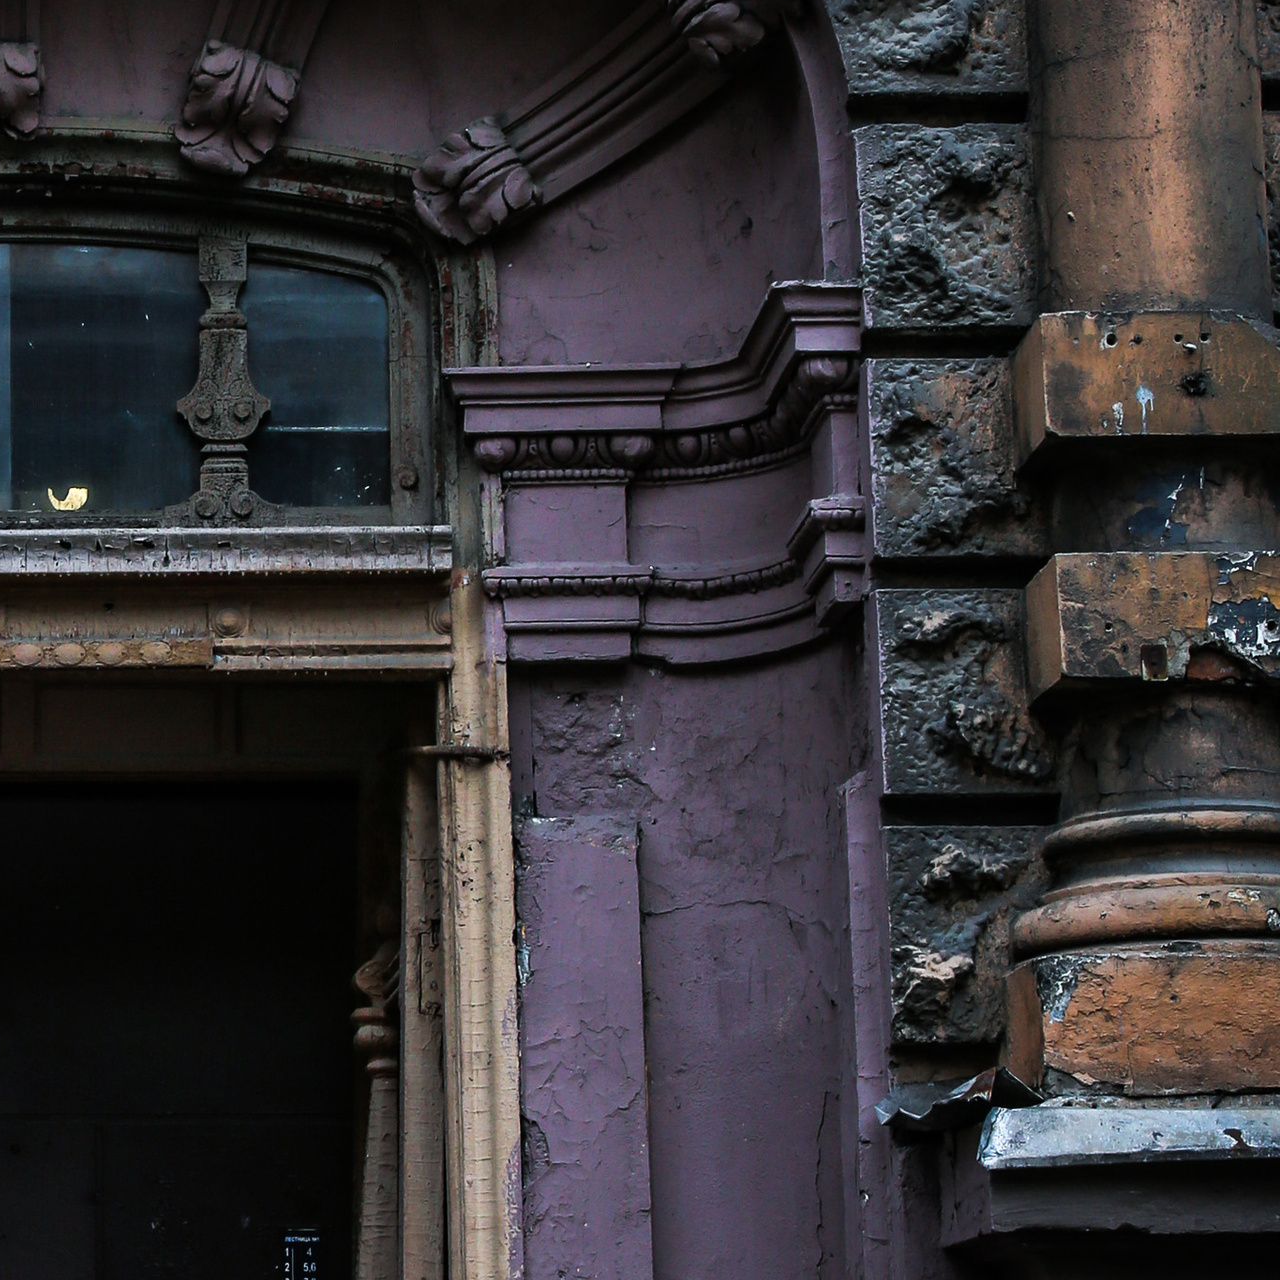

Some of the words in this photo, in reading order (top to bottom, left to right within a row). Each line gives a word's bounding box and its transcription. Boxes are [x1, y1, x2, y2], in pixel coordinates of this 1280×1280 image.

[285, 1247, 289, 1256] 1
[306, 1247, 312, 1256] 4
[284, 1262, 290, 1272] 2
